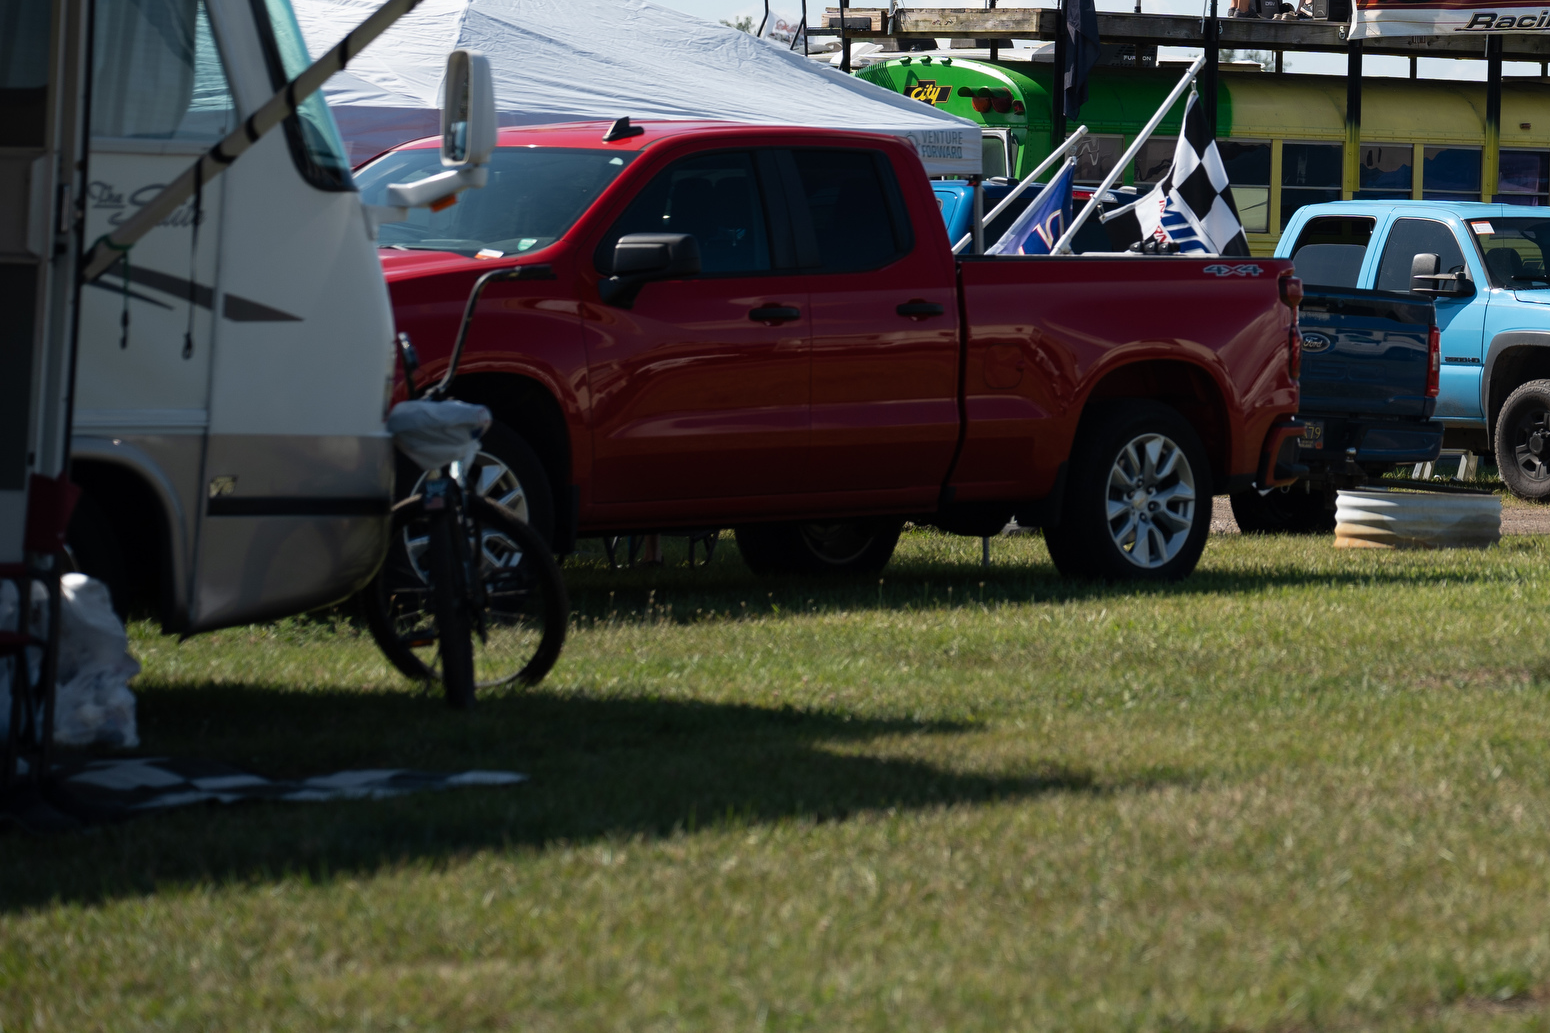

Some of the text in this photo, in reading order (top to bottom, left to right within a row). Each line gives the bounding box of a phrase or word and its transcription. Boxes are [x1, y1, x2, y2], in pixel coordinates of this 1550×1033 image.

[911, 84, 941, 104] city
[922, 130, 963, 144] VENTURE
[922, 145, 963, 159] FORWARD
[1303, 336, 1323, 348] Ford
